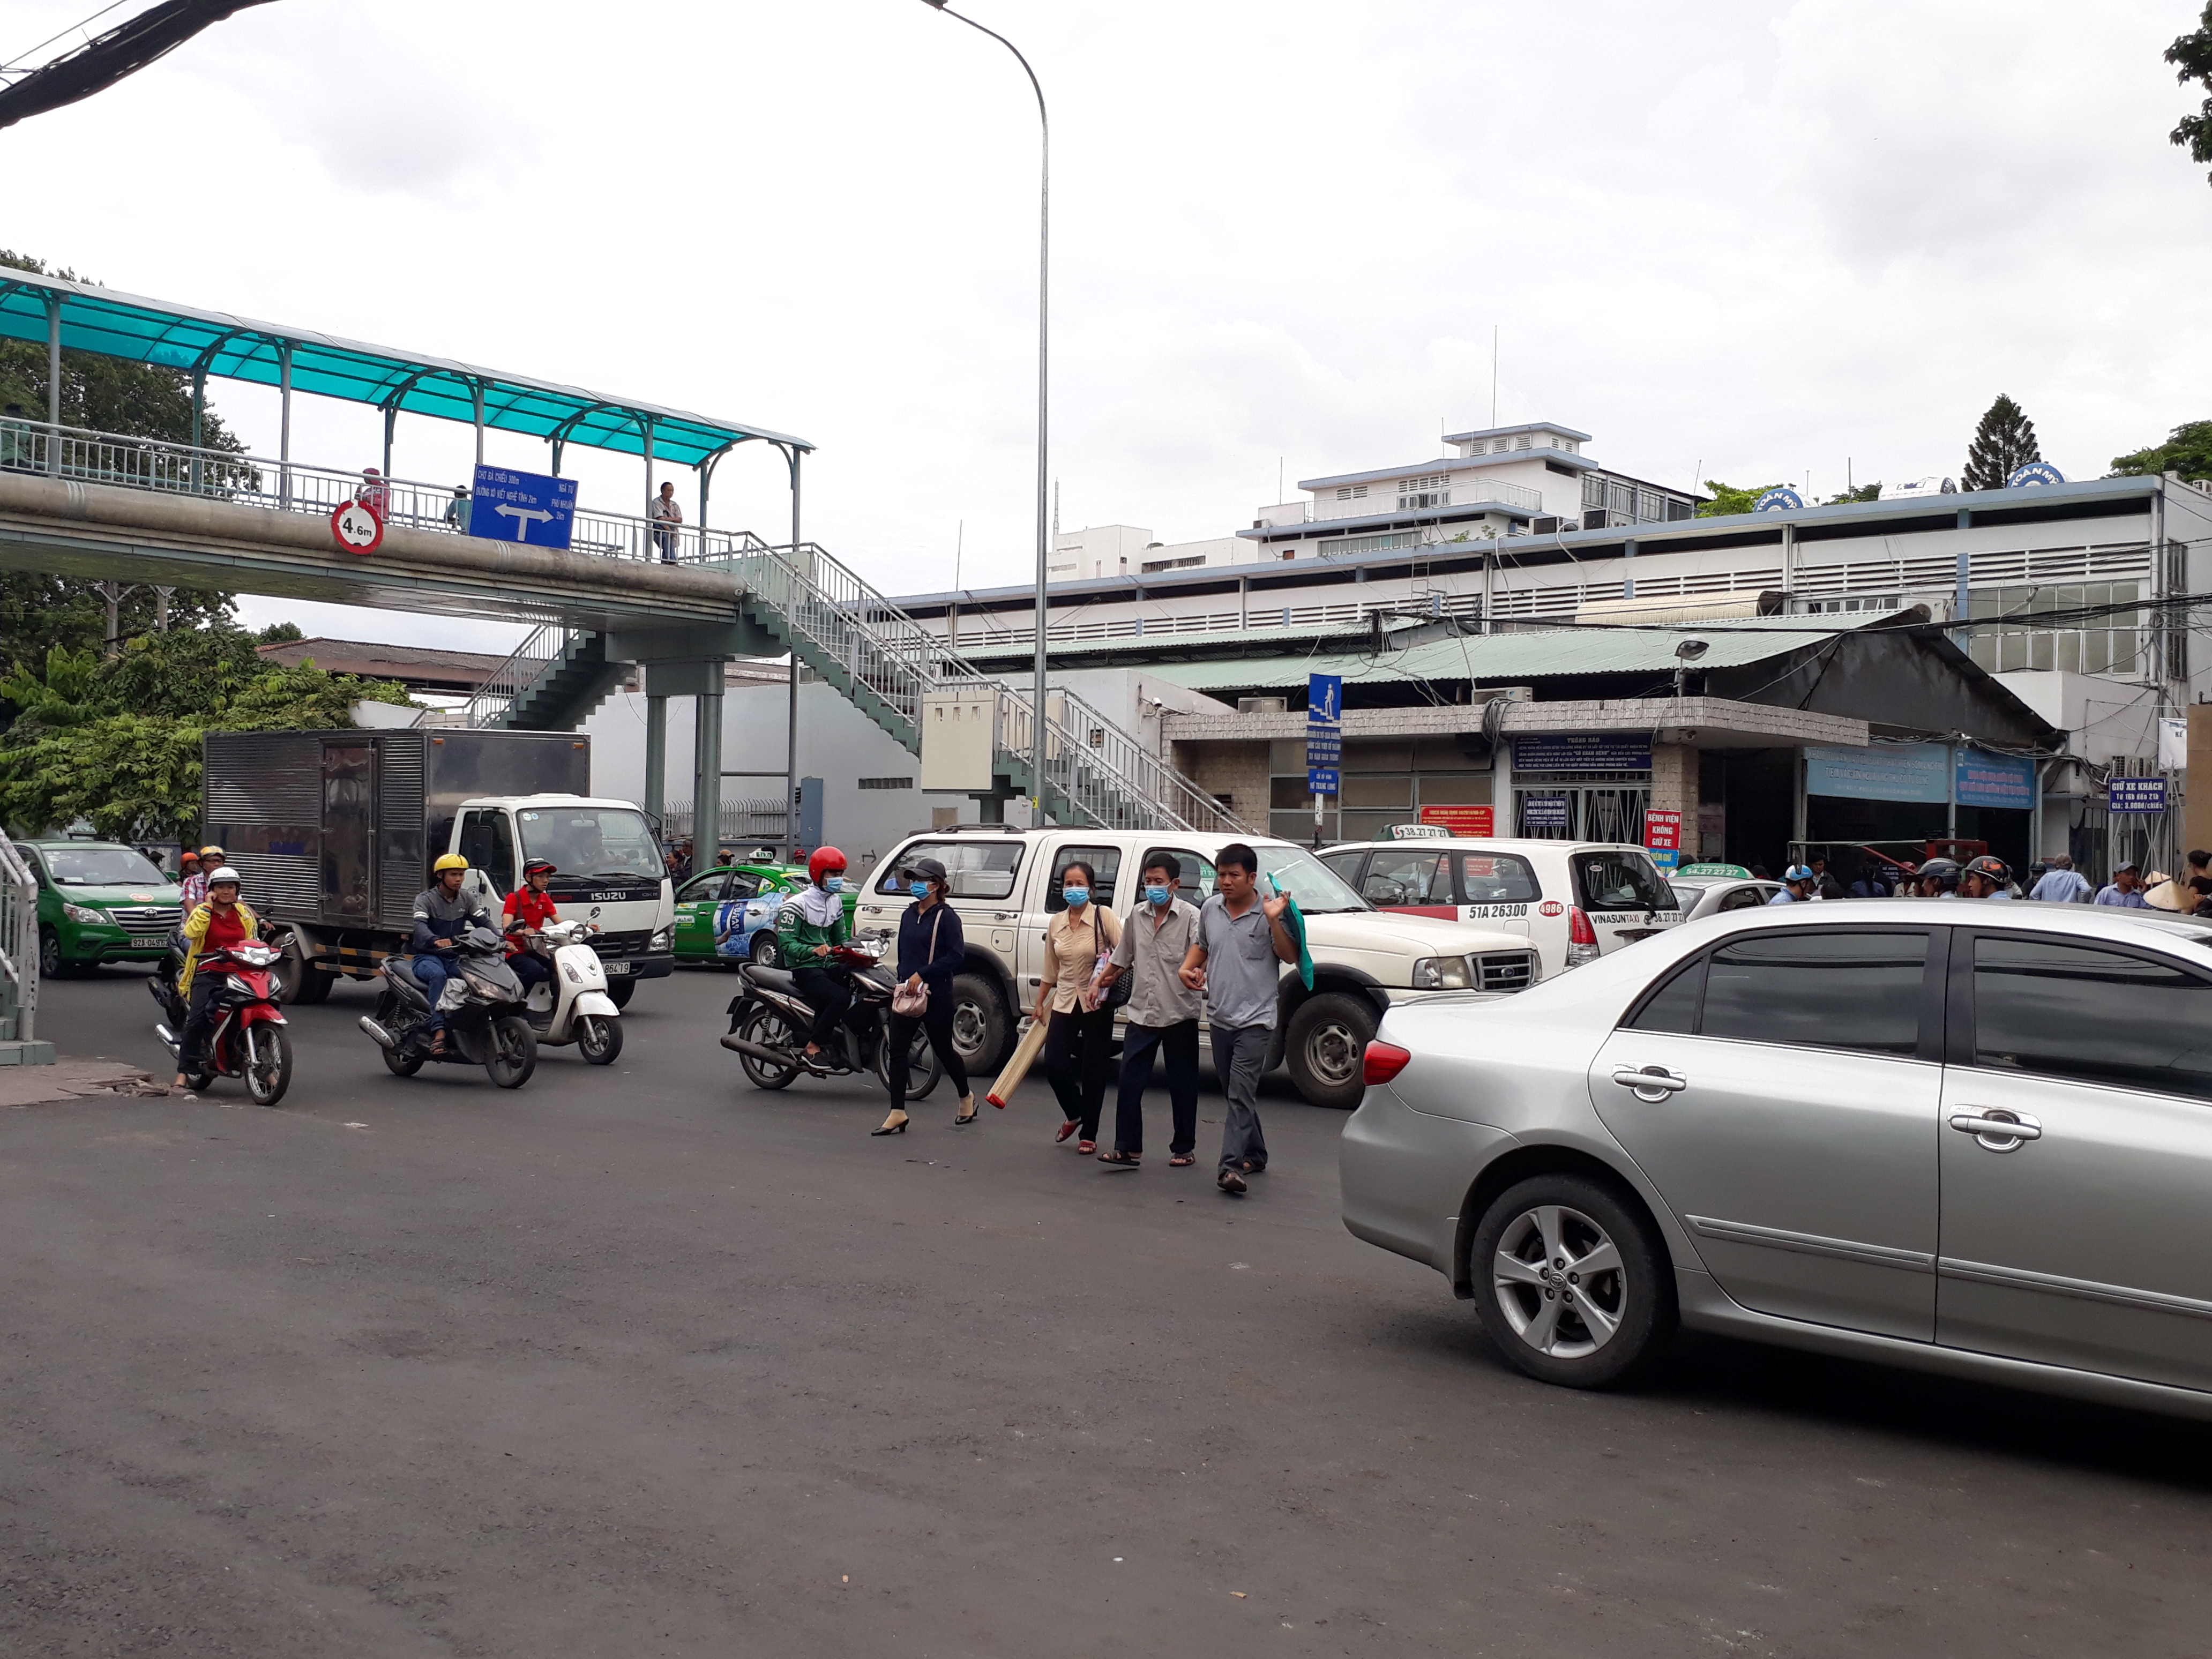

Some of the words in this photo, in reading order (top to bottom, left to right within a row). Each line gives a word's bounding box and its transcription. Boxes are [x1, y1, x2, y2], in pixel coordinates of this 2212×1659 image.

[342, 517, 372, 537] 4.6m
[2112, 781, 2125, 790] GIỮ
[2126, 782, 2136, 790] XE
[2138, 781, 2163, 790] KHÁCH
[1648, 813, 1663, 823] BỆNH
[1665, 814, 1679, 824] VIỆN
[1405, 827, 1425, 836] 38.27
[1428, 828, 1436, 836] 27
[1652, 825, 1673, 835] KHÔNG
[1652, 837, 1662, 846] GIỮ
[591, 892, 626, 901] ISUZU
[1469, 906, 1489, 918] 51A
[1540, 903, 1562, 914] 4986
[781, 912, 795, 925] 39
